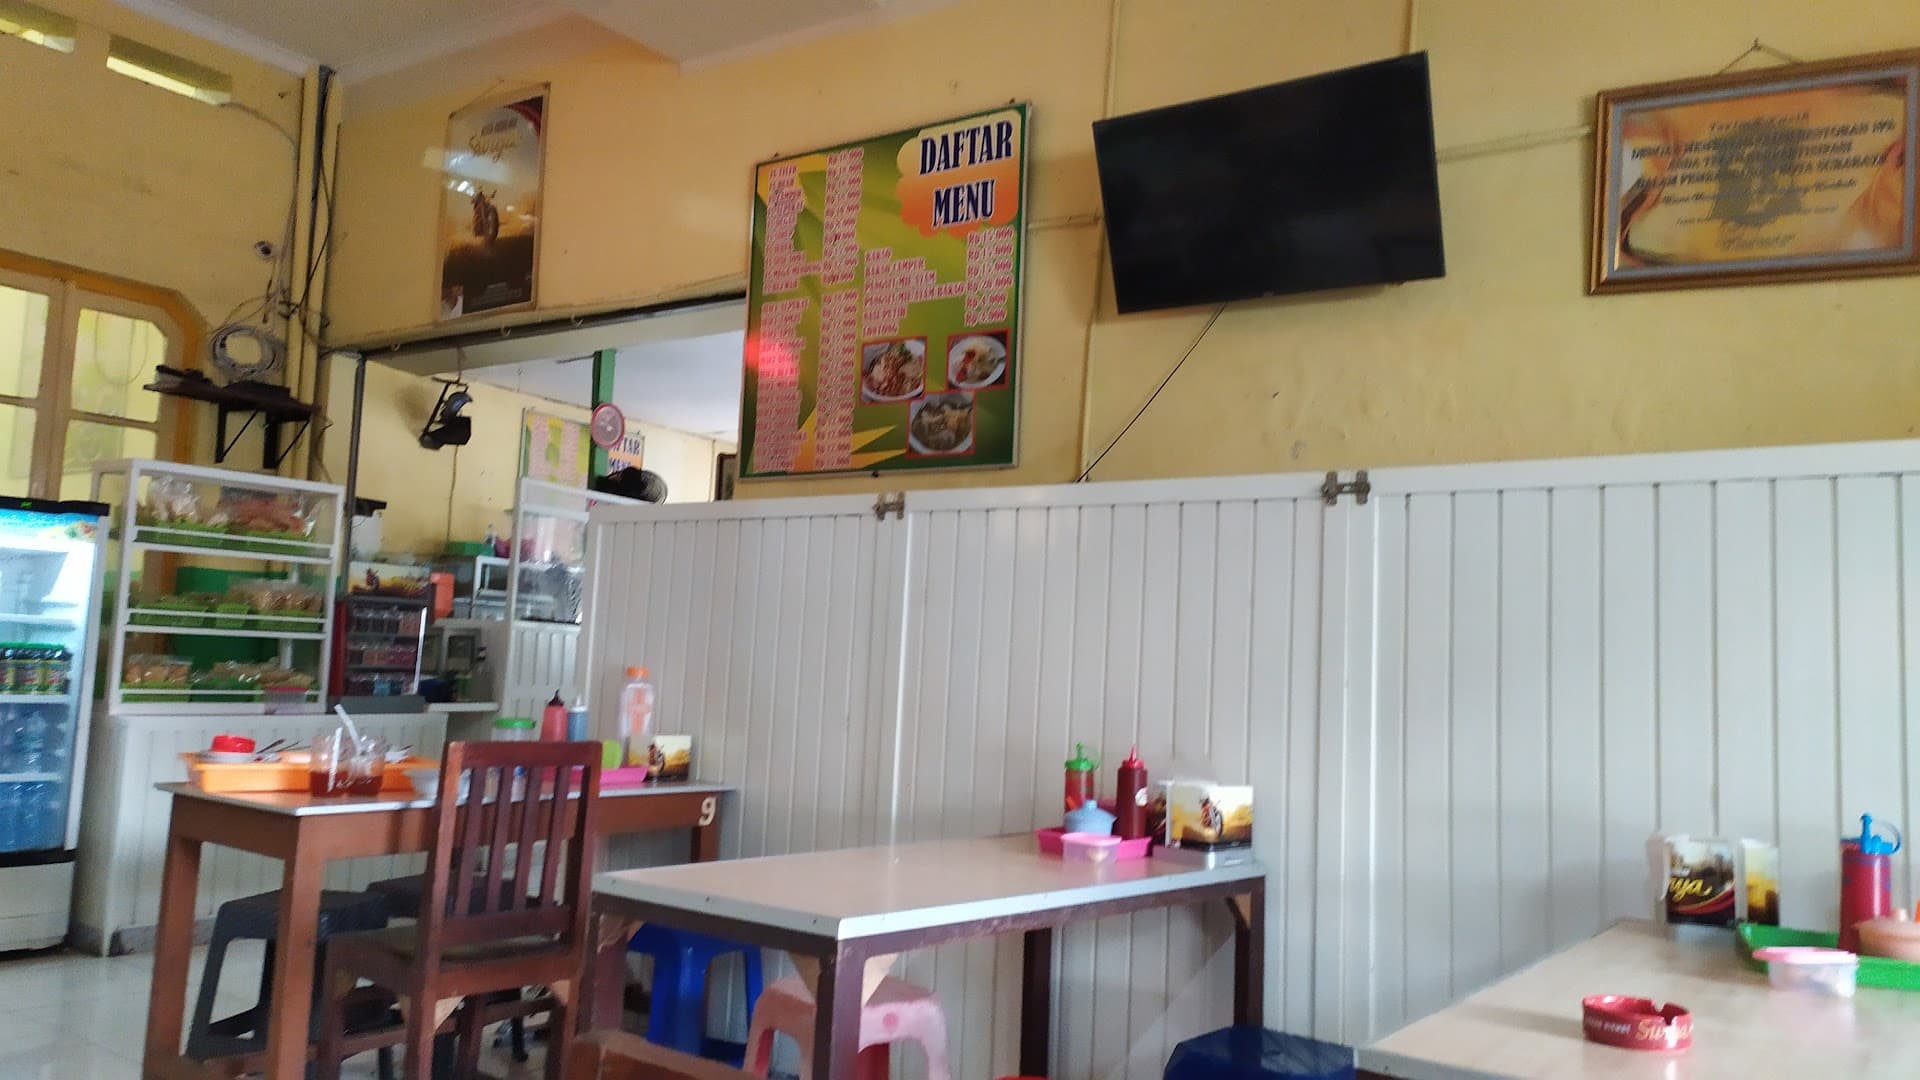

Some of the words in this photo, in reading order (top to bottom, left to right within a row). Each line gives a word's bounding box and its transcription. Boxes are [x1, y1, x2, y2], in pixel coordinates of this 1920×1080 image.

[920, 121, 1013, 175] DAFTAR
[933, 179, 994, 227] MENU
[698, 796, 717, 826] 9
